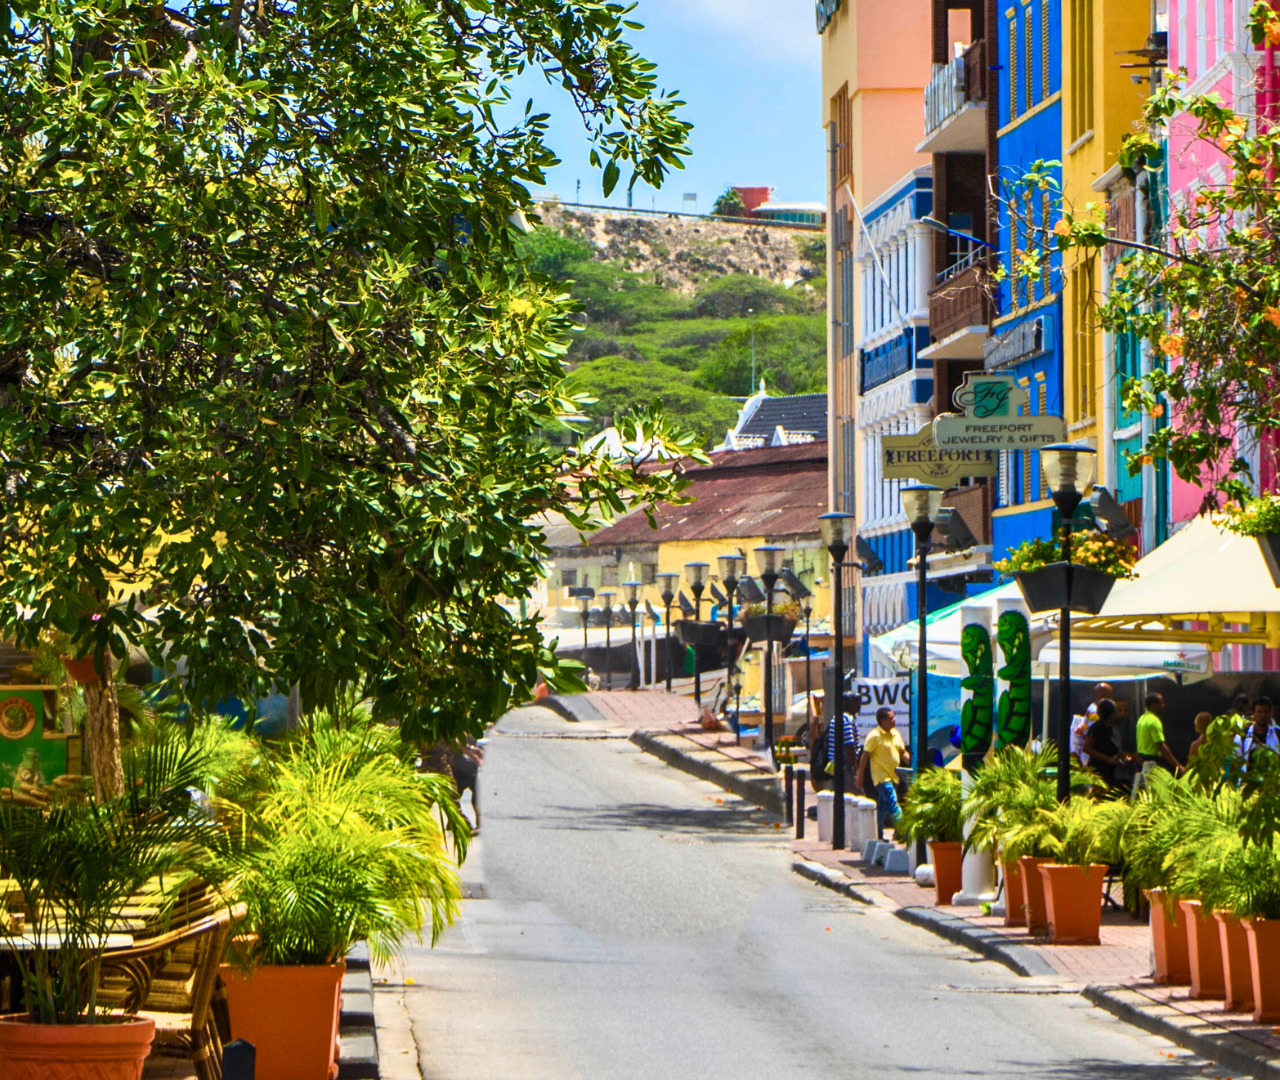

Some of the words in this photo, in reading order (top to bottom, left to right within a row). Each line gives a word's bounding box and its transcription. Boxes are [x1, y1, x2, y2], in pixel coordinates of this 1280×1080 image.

[965, 423, 1034, 433] FREEPORT
[942, 434, 1003, 445] JEWELRY
[1006, 435, 1015, 443] &
[1019, 434, 1056, 443] GIFTS
[896, 448, 982, 463] FREEPORT
